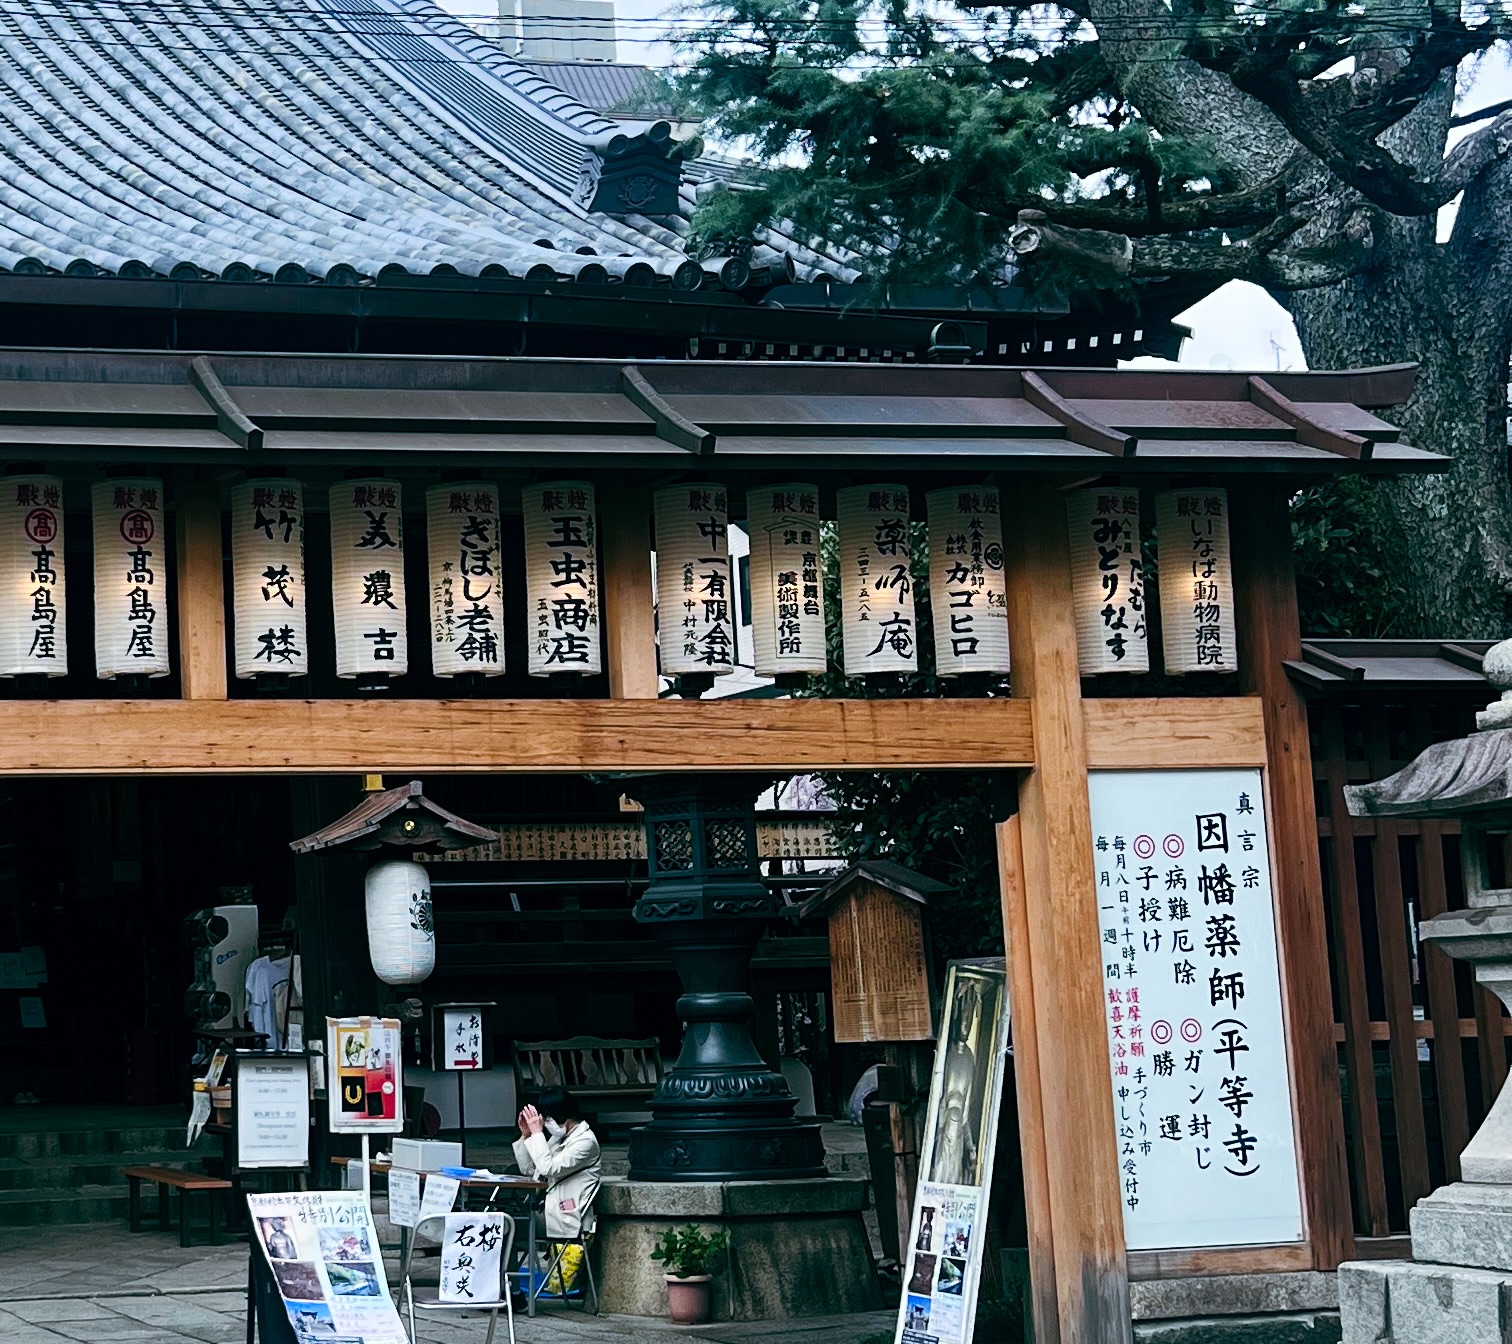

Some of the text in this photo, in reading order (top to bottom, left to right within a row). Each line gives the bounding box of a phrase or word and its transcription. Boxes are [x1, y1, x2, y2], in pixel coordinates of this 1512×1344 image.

[254, 510, 301, 664] 竹茂楼
[355, 510, 398, 661] 美濃吉
[456, 516, 498, 663] ぎぼし老舗
[545, 516, 590, 665] 玉虫商店
[682, 599, 698, 656] 中村元隆
[695, 517, 732, 666] 中一有限会社
[777, 571, 801, 654] 美術製作所
[802, 551, 819, 616] 京都舞台
[866, 518, 913, 659] 薬師庵
[945, 561, 981, 657] カゴヒロ
[1092, 518, 1129, 661] みどりなす
[1191, 519, 1225, 665] いなば動物病院
[1235, 792, 1260, 889] 真言宗
[1136, 866, 1162, 953] 子授け
[1165, 865, 1197, 985] 病難厄除
[1196, 813, 1261, 1177] 因幡薬師(平等寺)
[1117, 1086, 1139, 1212] 申し込み受付中
[1133, 1067, 1152, 1156] 手づくり市
[1183, 1047, 1212, 1170] ガン封じ
